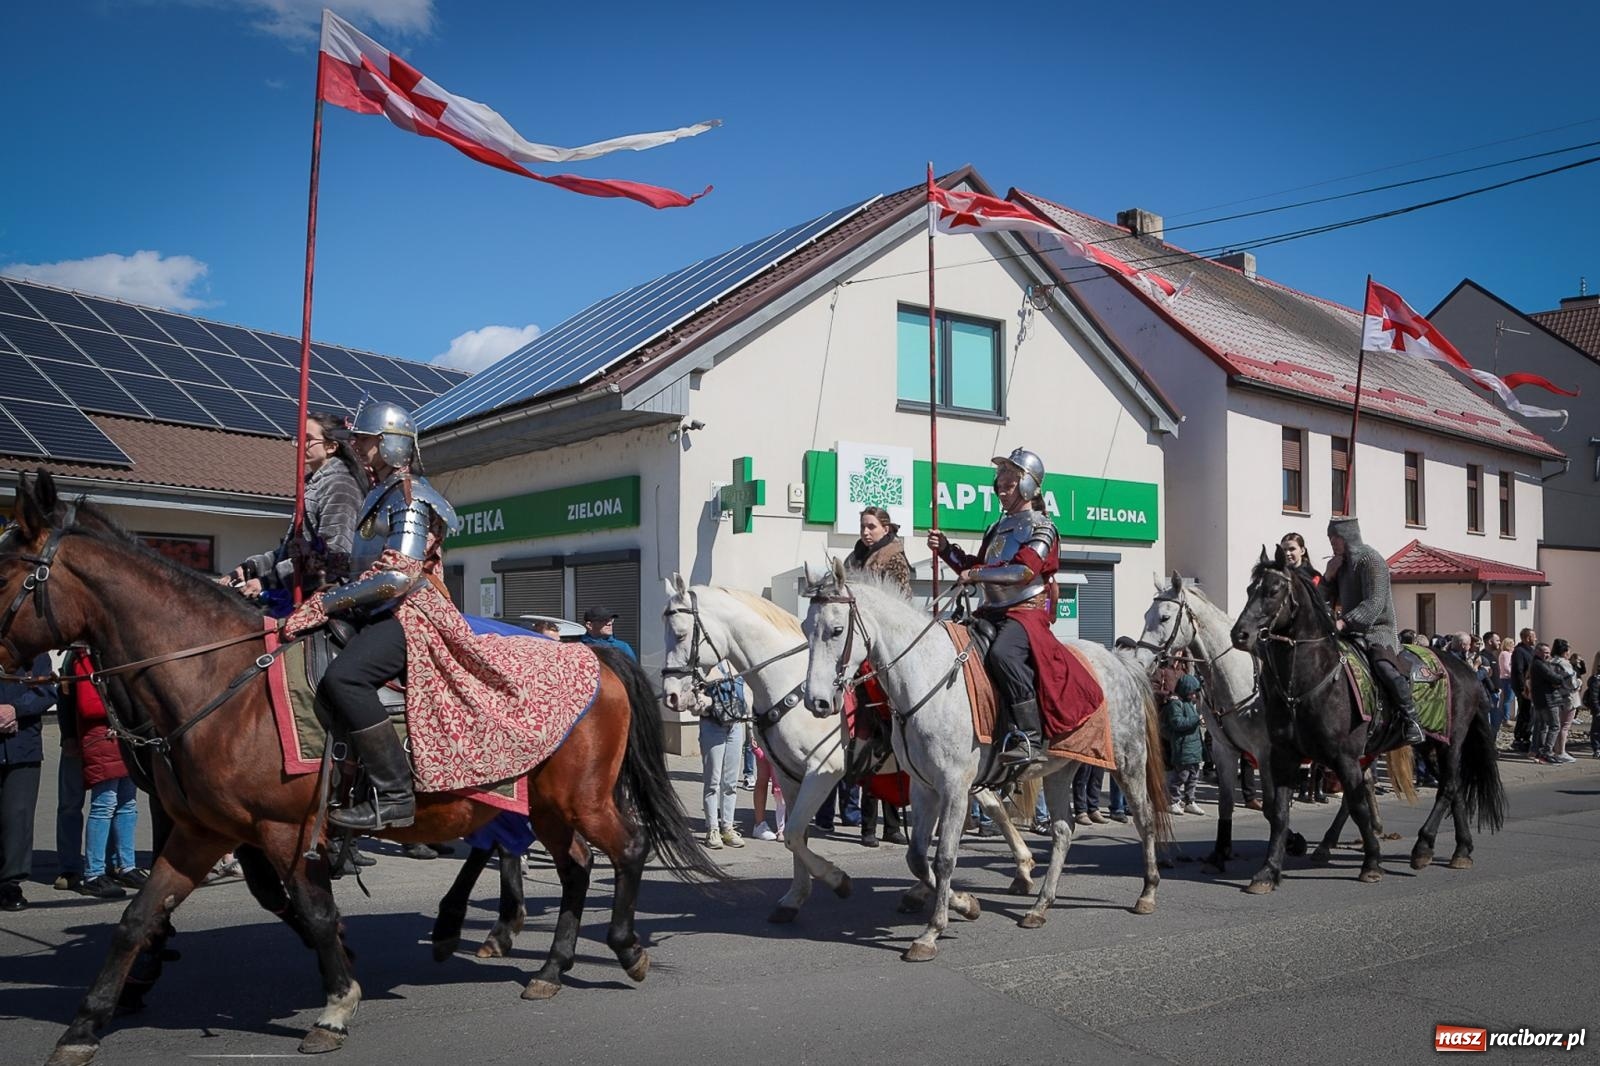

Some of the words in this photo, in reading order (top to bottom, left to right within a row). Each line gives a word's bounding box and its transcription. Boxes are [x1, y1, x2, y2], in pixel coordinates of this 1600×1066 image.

[567, 497, 623, 521] ZIELONA
[929, 481, 1060, 517] APTA
[1086, 506, 1147, 524] ZIELONA
